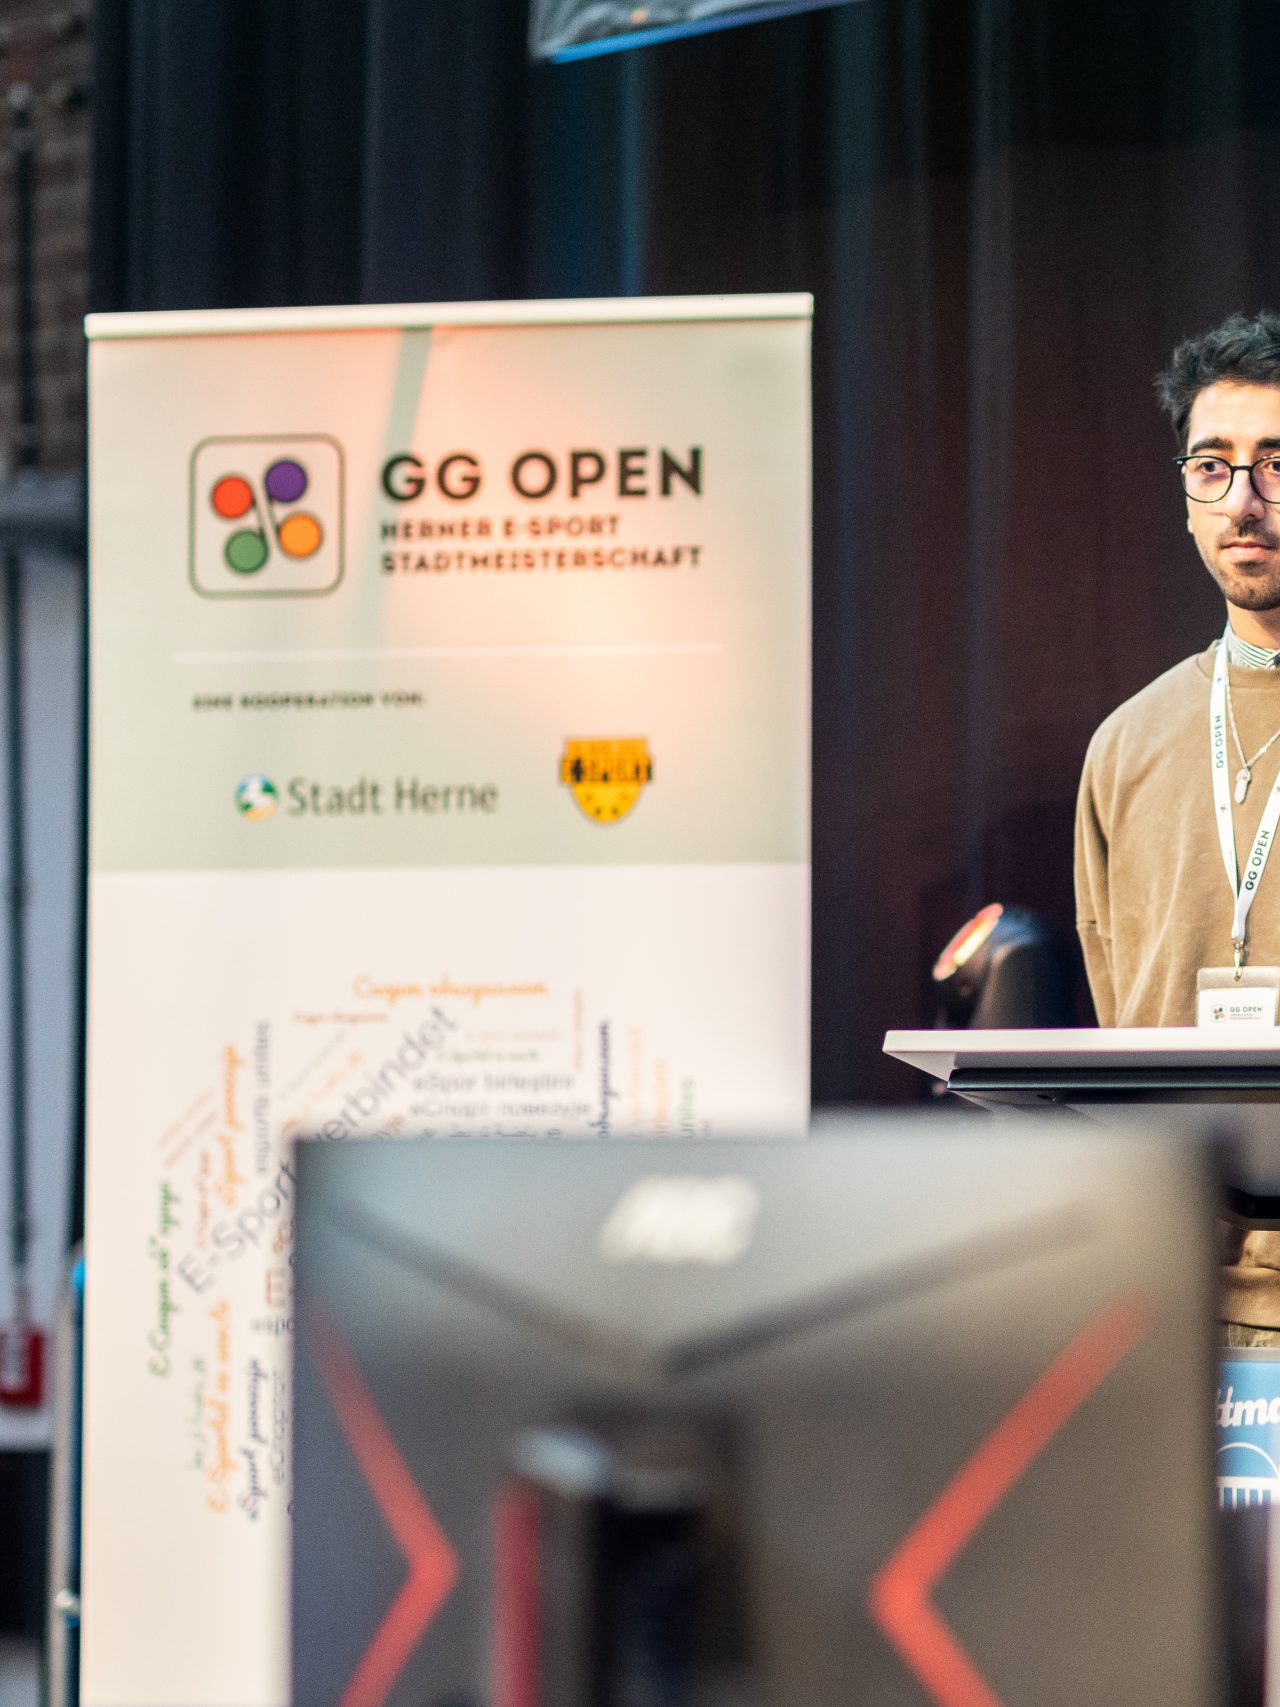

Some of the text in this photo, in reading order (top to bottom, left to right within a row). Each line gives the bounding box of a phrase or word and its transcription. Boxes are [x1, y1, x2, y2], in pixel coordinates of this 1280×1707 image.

[382, 447, 703, 501] GG OPEN
[381, 514, 619, 541] HERNER E-SPORT
[382, 546, 703, 573] STADTMEISTERSCHAFT
[1215, 715, 1224, 769] GG OPEN
[286, 774, 498, 816] Stadt Herne
[1245, 830, 1270, 890] GG OPEN
